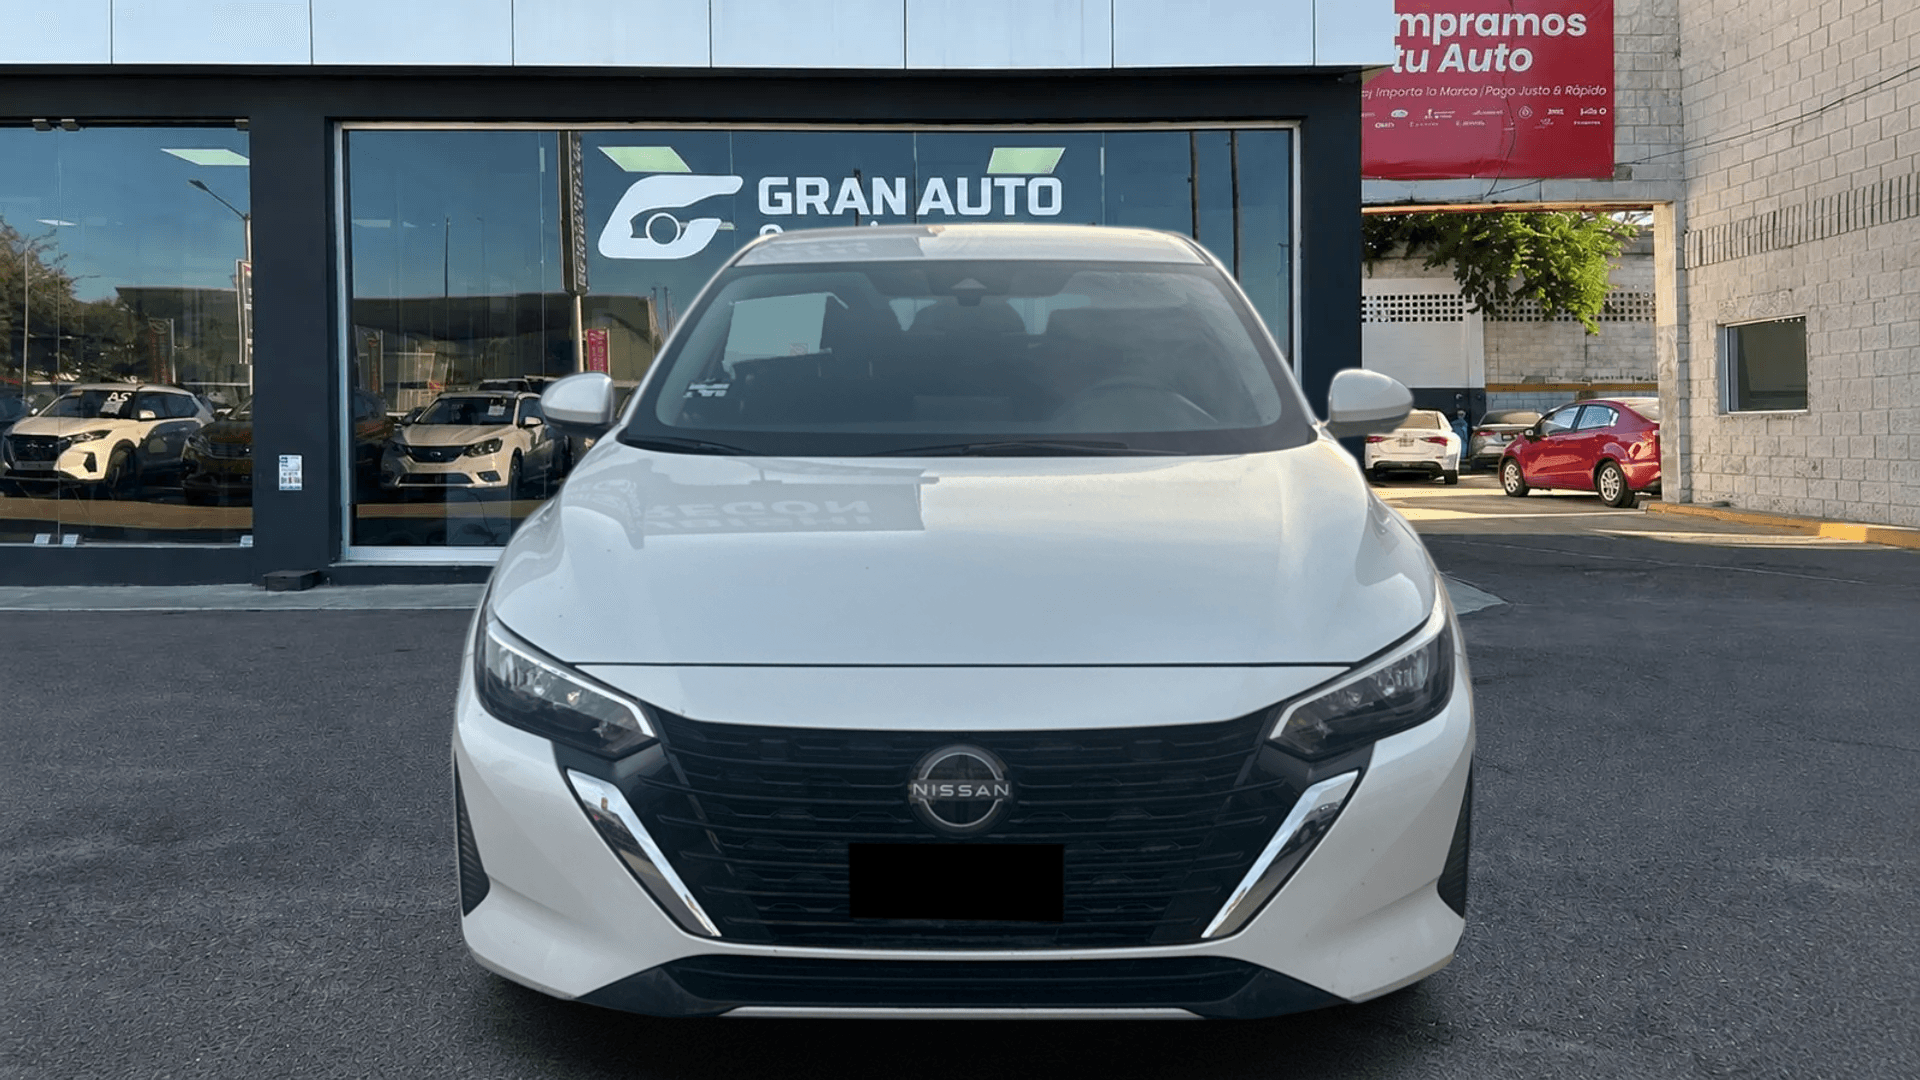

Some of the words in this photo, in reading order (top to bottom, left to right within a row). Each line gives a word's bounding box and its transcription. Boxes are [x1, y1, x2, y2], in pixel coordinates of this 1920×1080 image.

[1395, 12, 1587, 45] mpramos
[1393, 45, 1429, 73] tu
[1437, 43, 1533, 73] Auto
[1375, 87, 1423, 99] Importa
[1426, 86, 1437, 96] la
[1439, 87, 1478, 96] Marca
[1518, 86, 1551, 96] Justo
[758, 177, 906, 216] GRAN
[916, 177, 1062, 216] AUTO
[912, 783, 1009, 797] NISSAN
